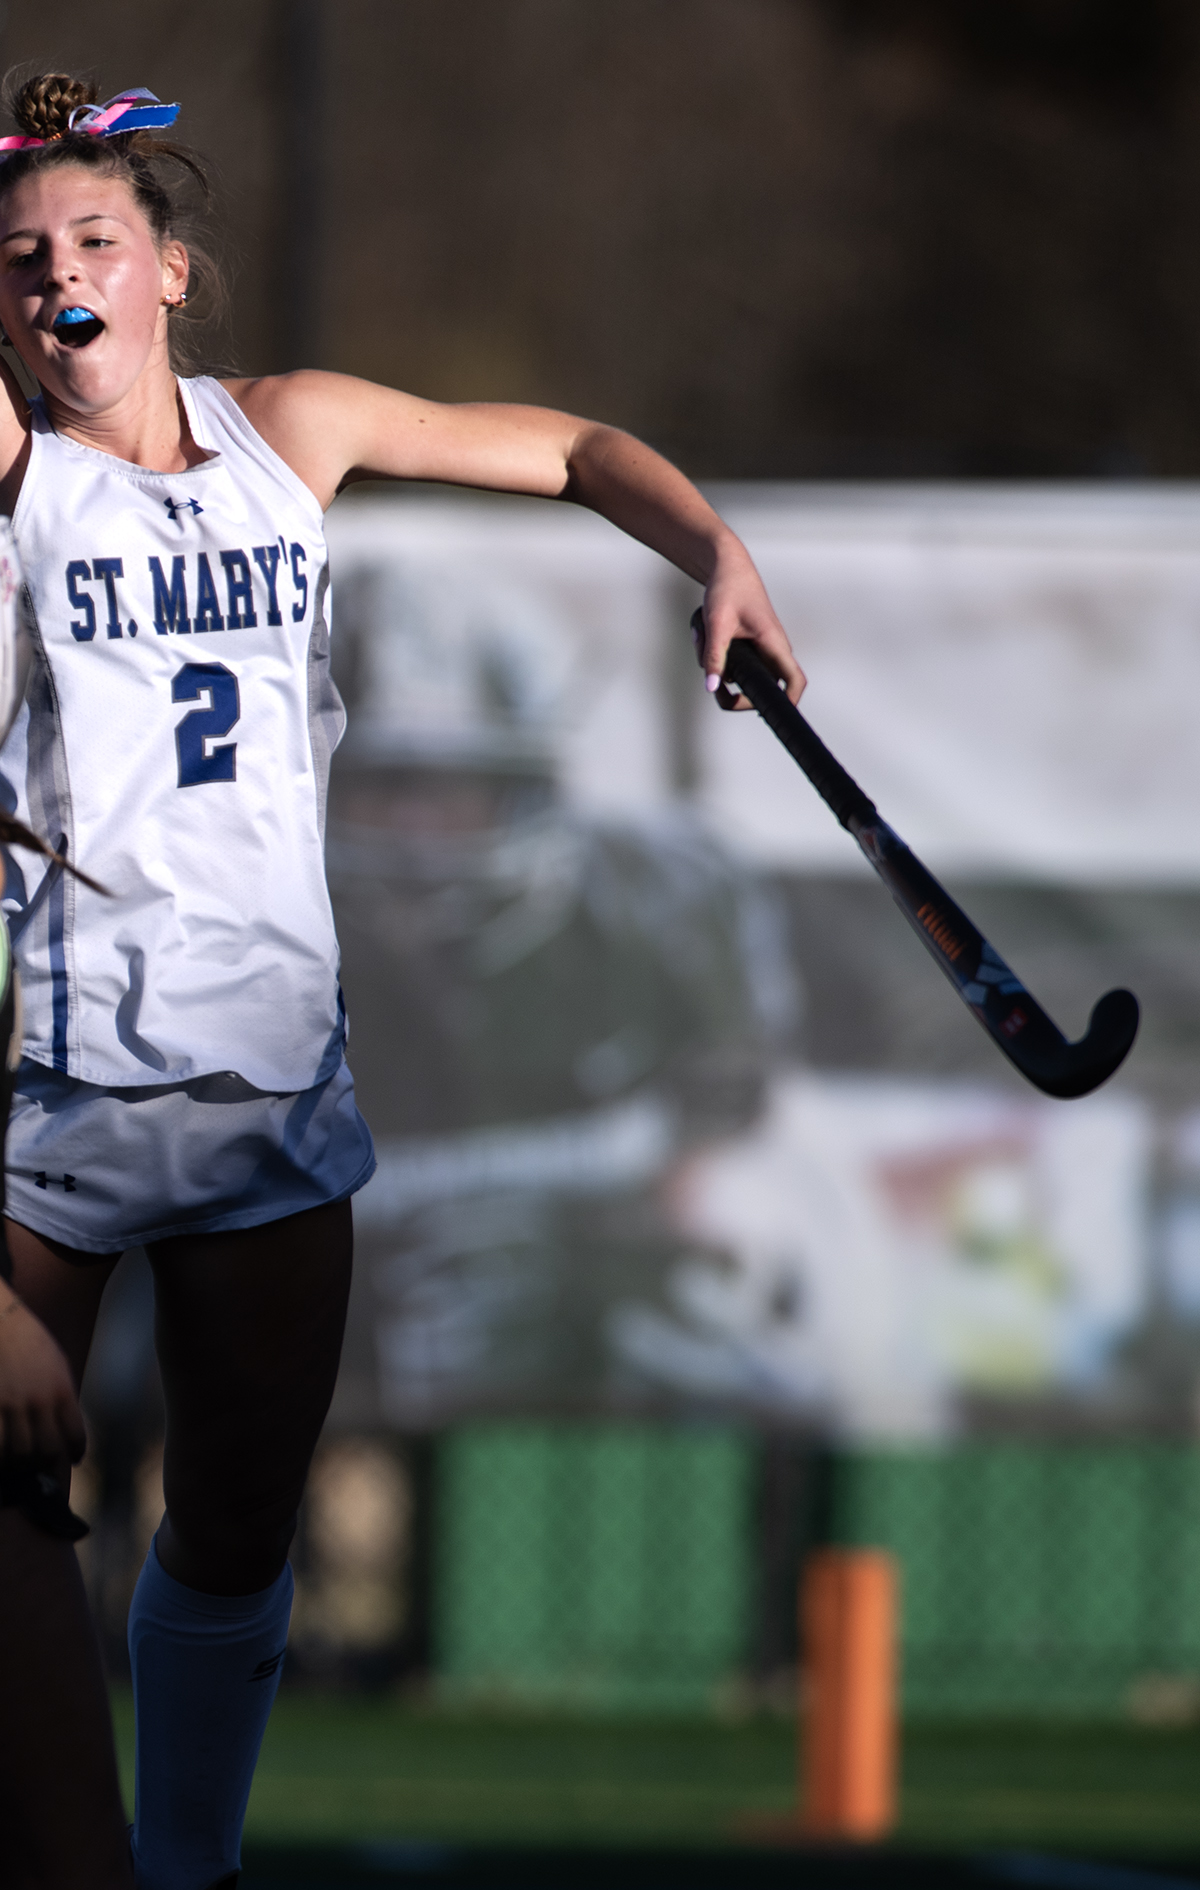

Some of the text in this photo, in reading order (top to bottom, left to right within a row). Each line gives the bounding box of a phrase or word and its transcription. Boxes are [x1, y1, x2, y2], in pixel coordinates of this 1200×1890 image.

[65, 557, 139, 642] ST.
[147, 534, 309, 635] MARY'S
[170, 661, 241, 789] 2
